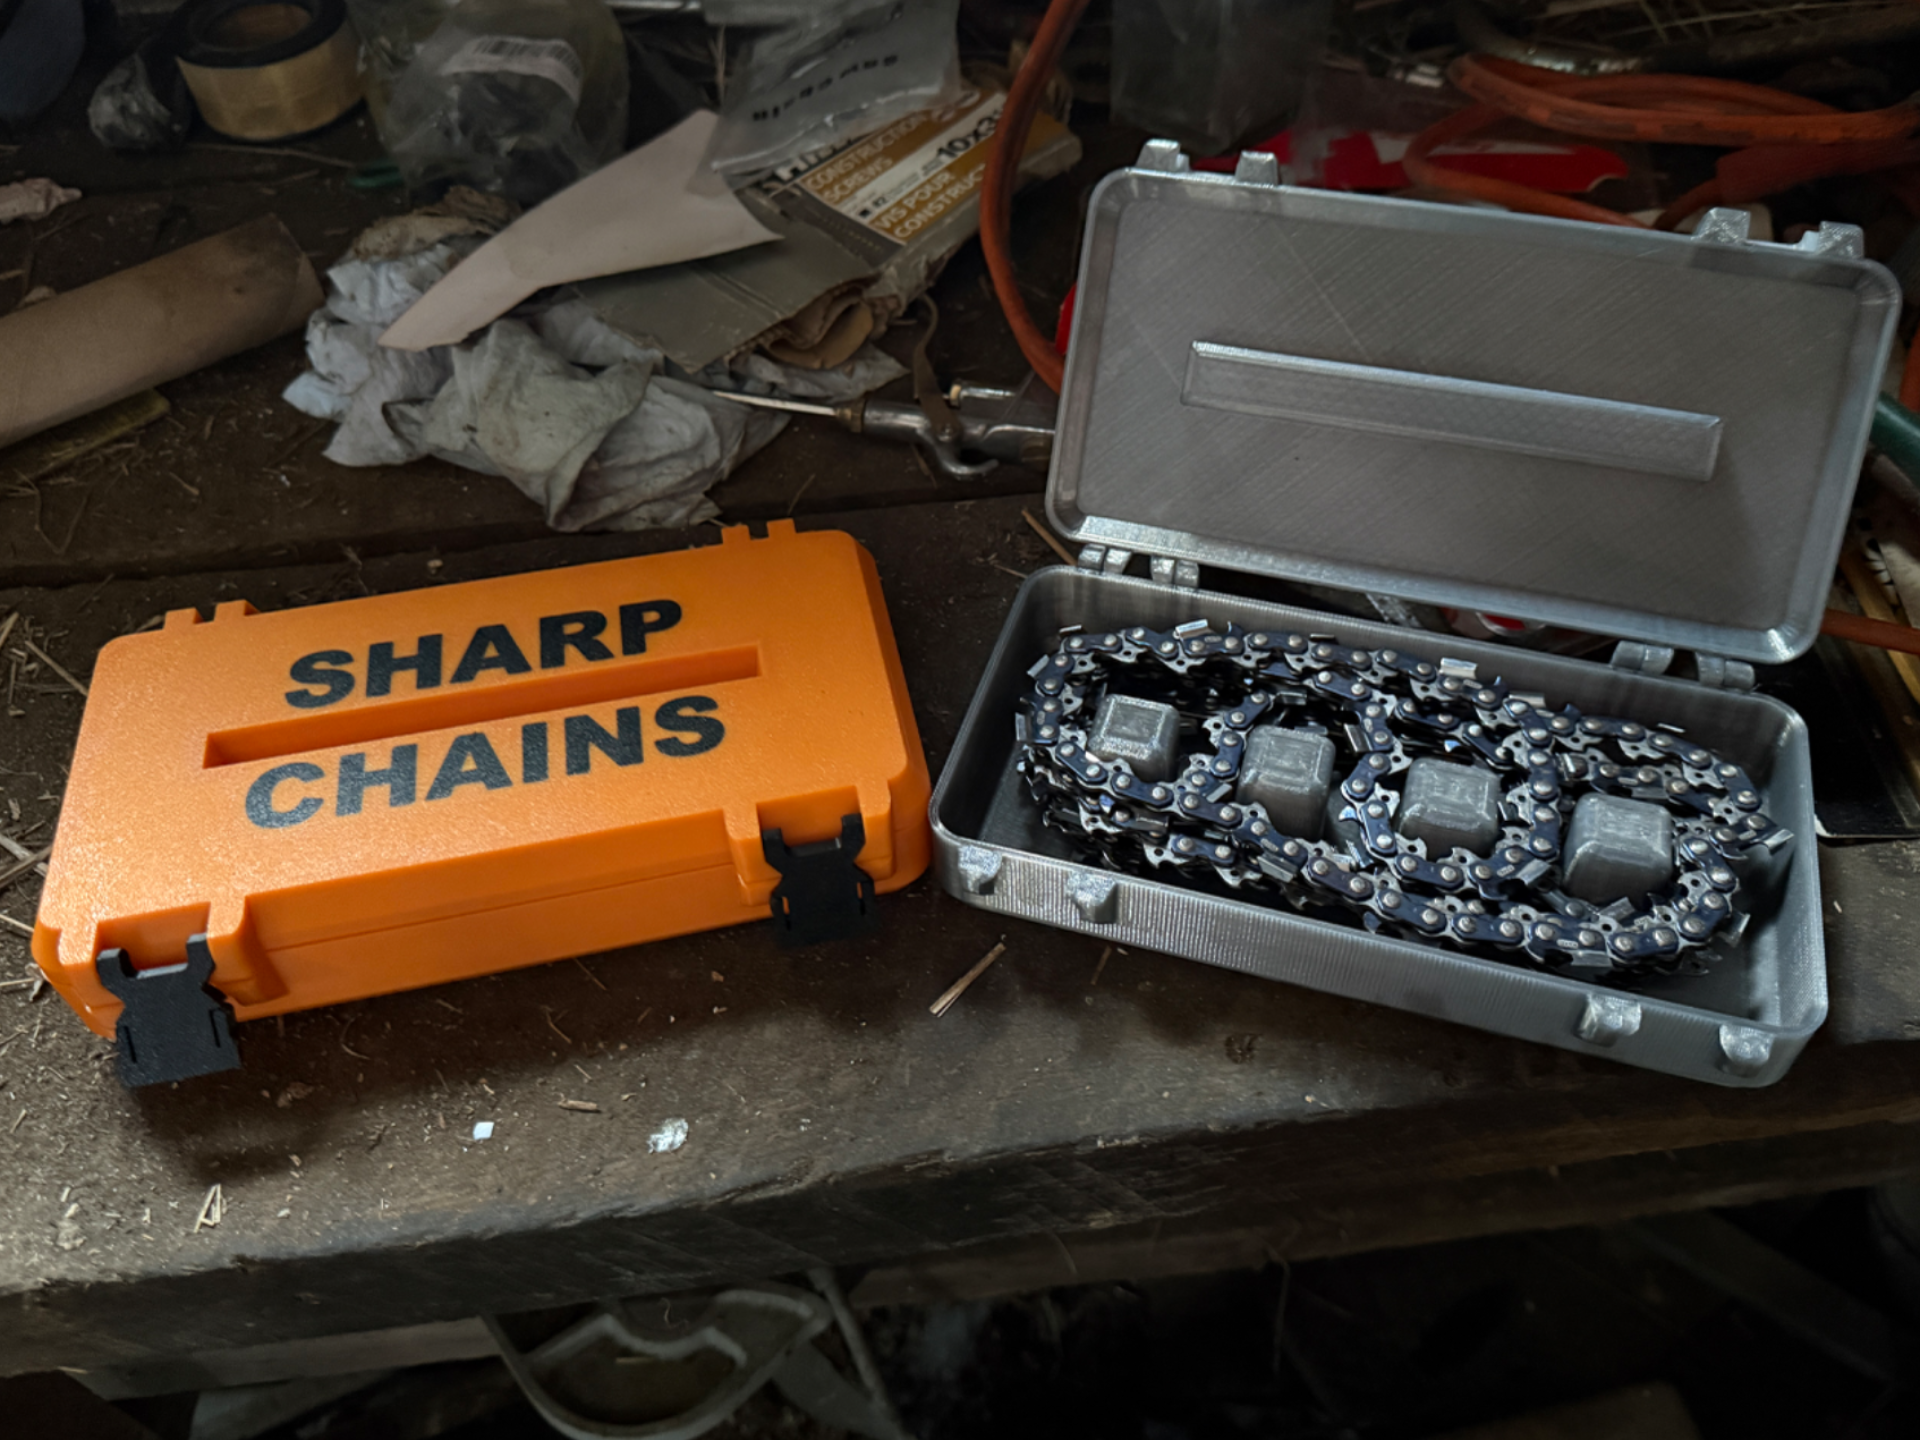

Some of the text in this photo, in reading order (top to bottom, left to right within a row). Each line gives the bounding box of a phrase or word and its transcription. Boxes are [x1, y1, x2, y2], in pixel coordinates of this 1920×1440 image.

[805, 112, 928, 190] CONSTRUCTION
[824, 156, 893, 204] SCREWS
[872, 204, 908, 231] VIS
[907, 170, 957, 210] POUR
[284, 599, 682, 709] SHARP
[244, 696, 725, 829] CHAINS
